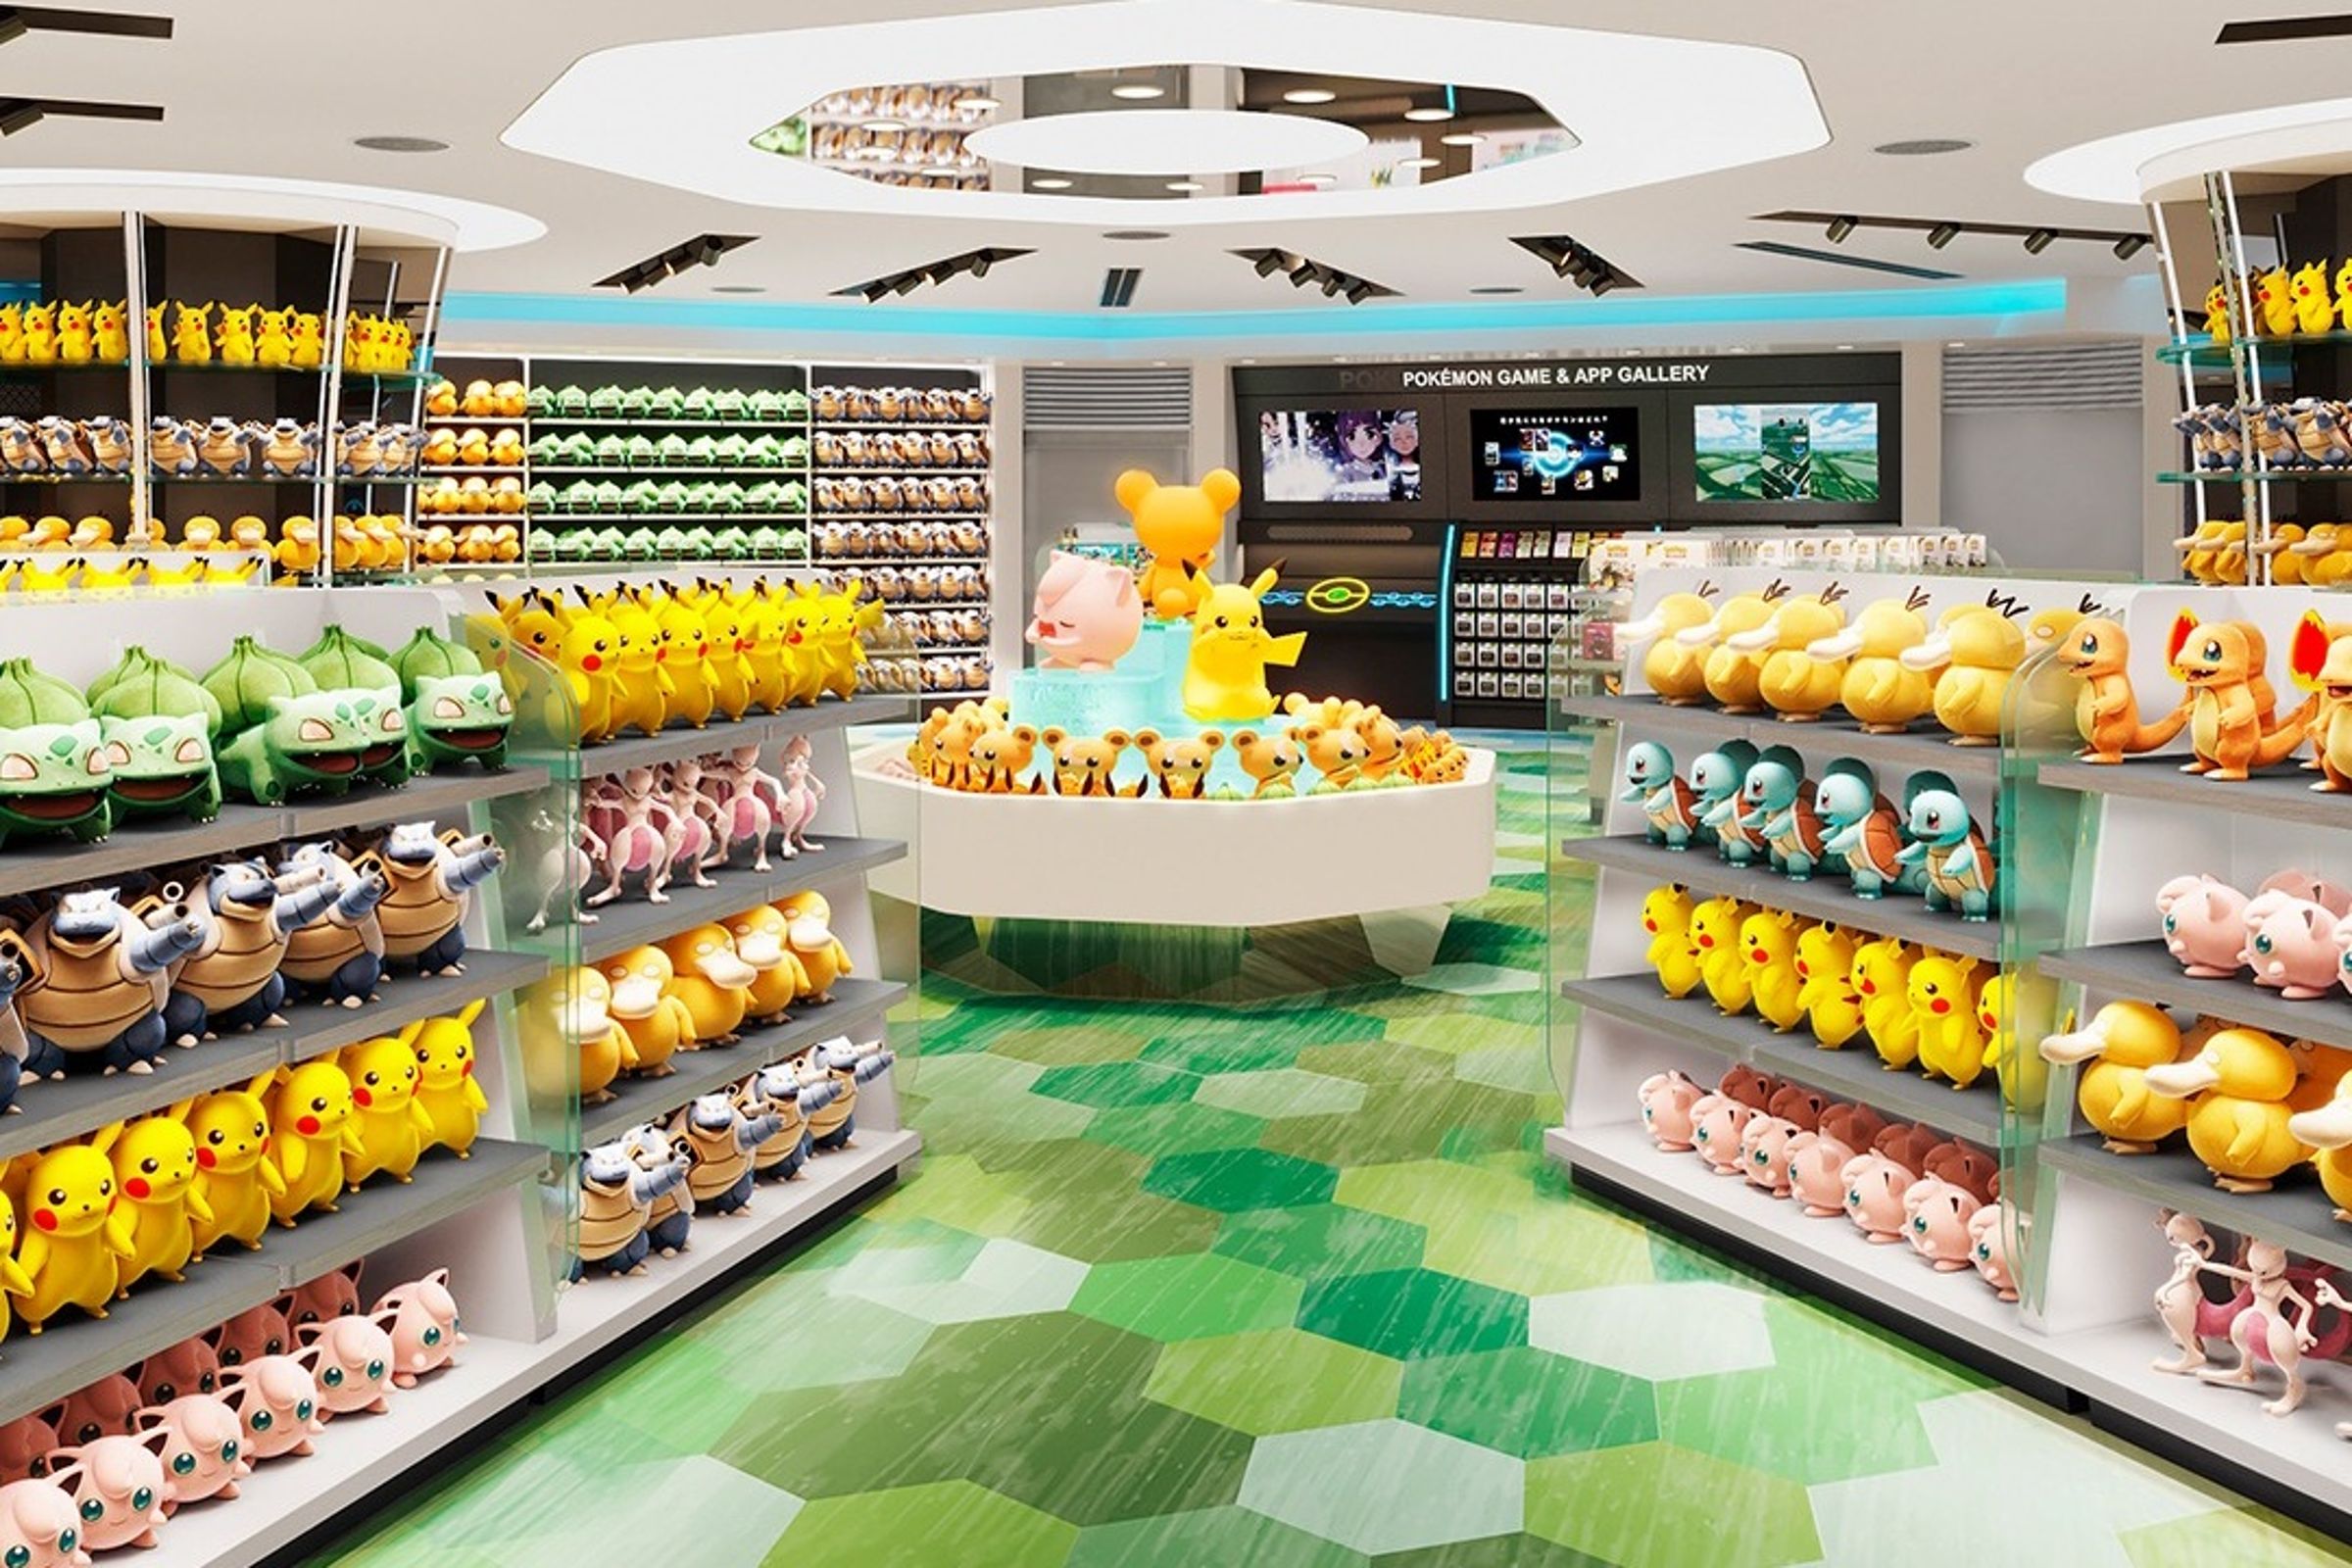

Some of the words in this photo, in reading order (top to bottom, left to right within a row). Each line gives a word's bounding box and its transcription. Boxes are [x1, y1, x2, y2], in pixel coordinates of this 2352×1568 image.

[1402, 367, 1494, 387] POKÉMON
[1496, 368, 1552, 385] GAME
[1555, 368, 1571, 384] &
[1573, 367, 1613, 384] APP
[1617, 364, 1711, 383] GALLERY
